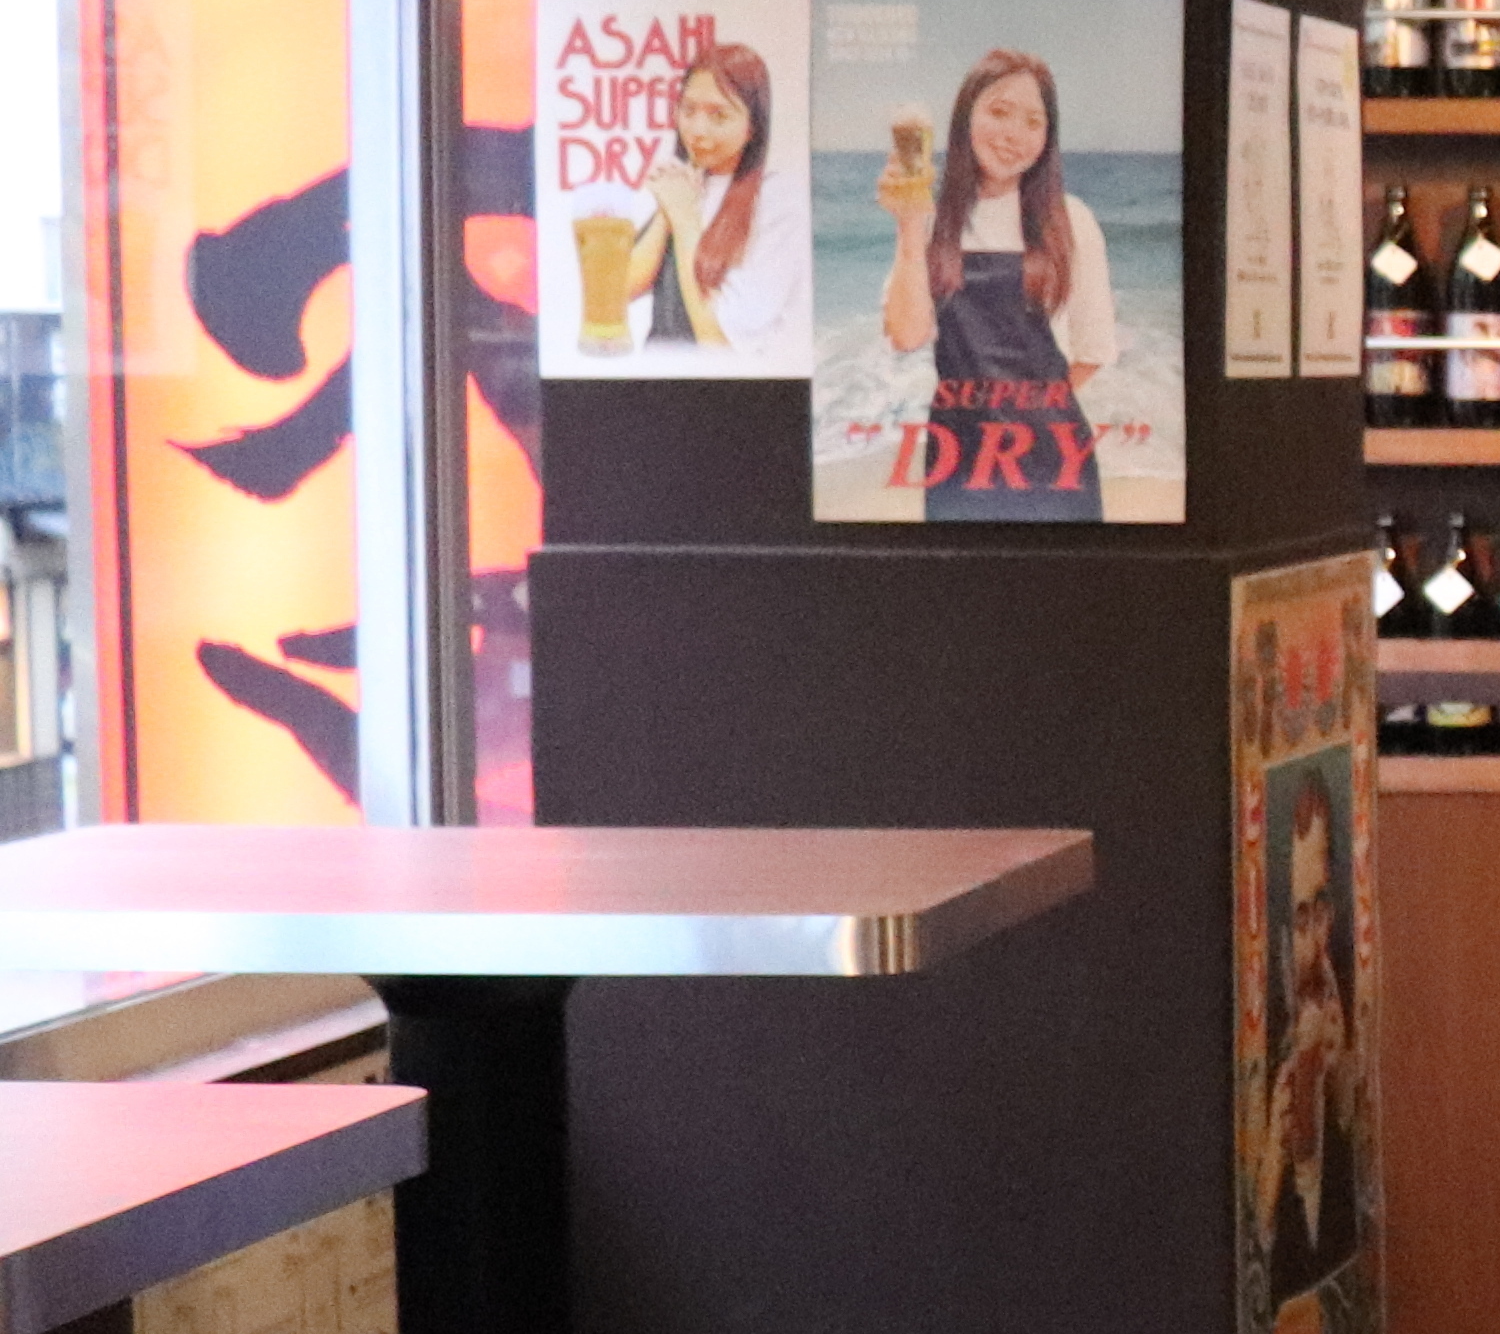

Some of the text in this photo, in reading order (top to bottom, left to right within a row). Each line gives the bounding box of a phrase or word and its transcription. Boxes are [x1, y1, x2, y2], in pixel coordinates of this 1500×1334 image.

[556, 13, 716, 70] ASAHI
[558, 136, 662, 191] DRY
[931, 379, 1072, 410] SUPER
